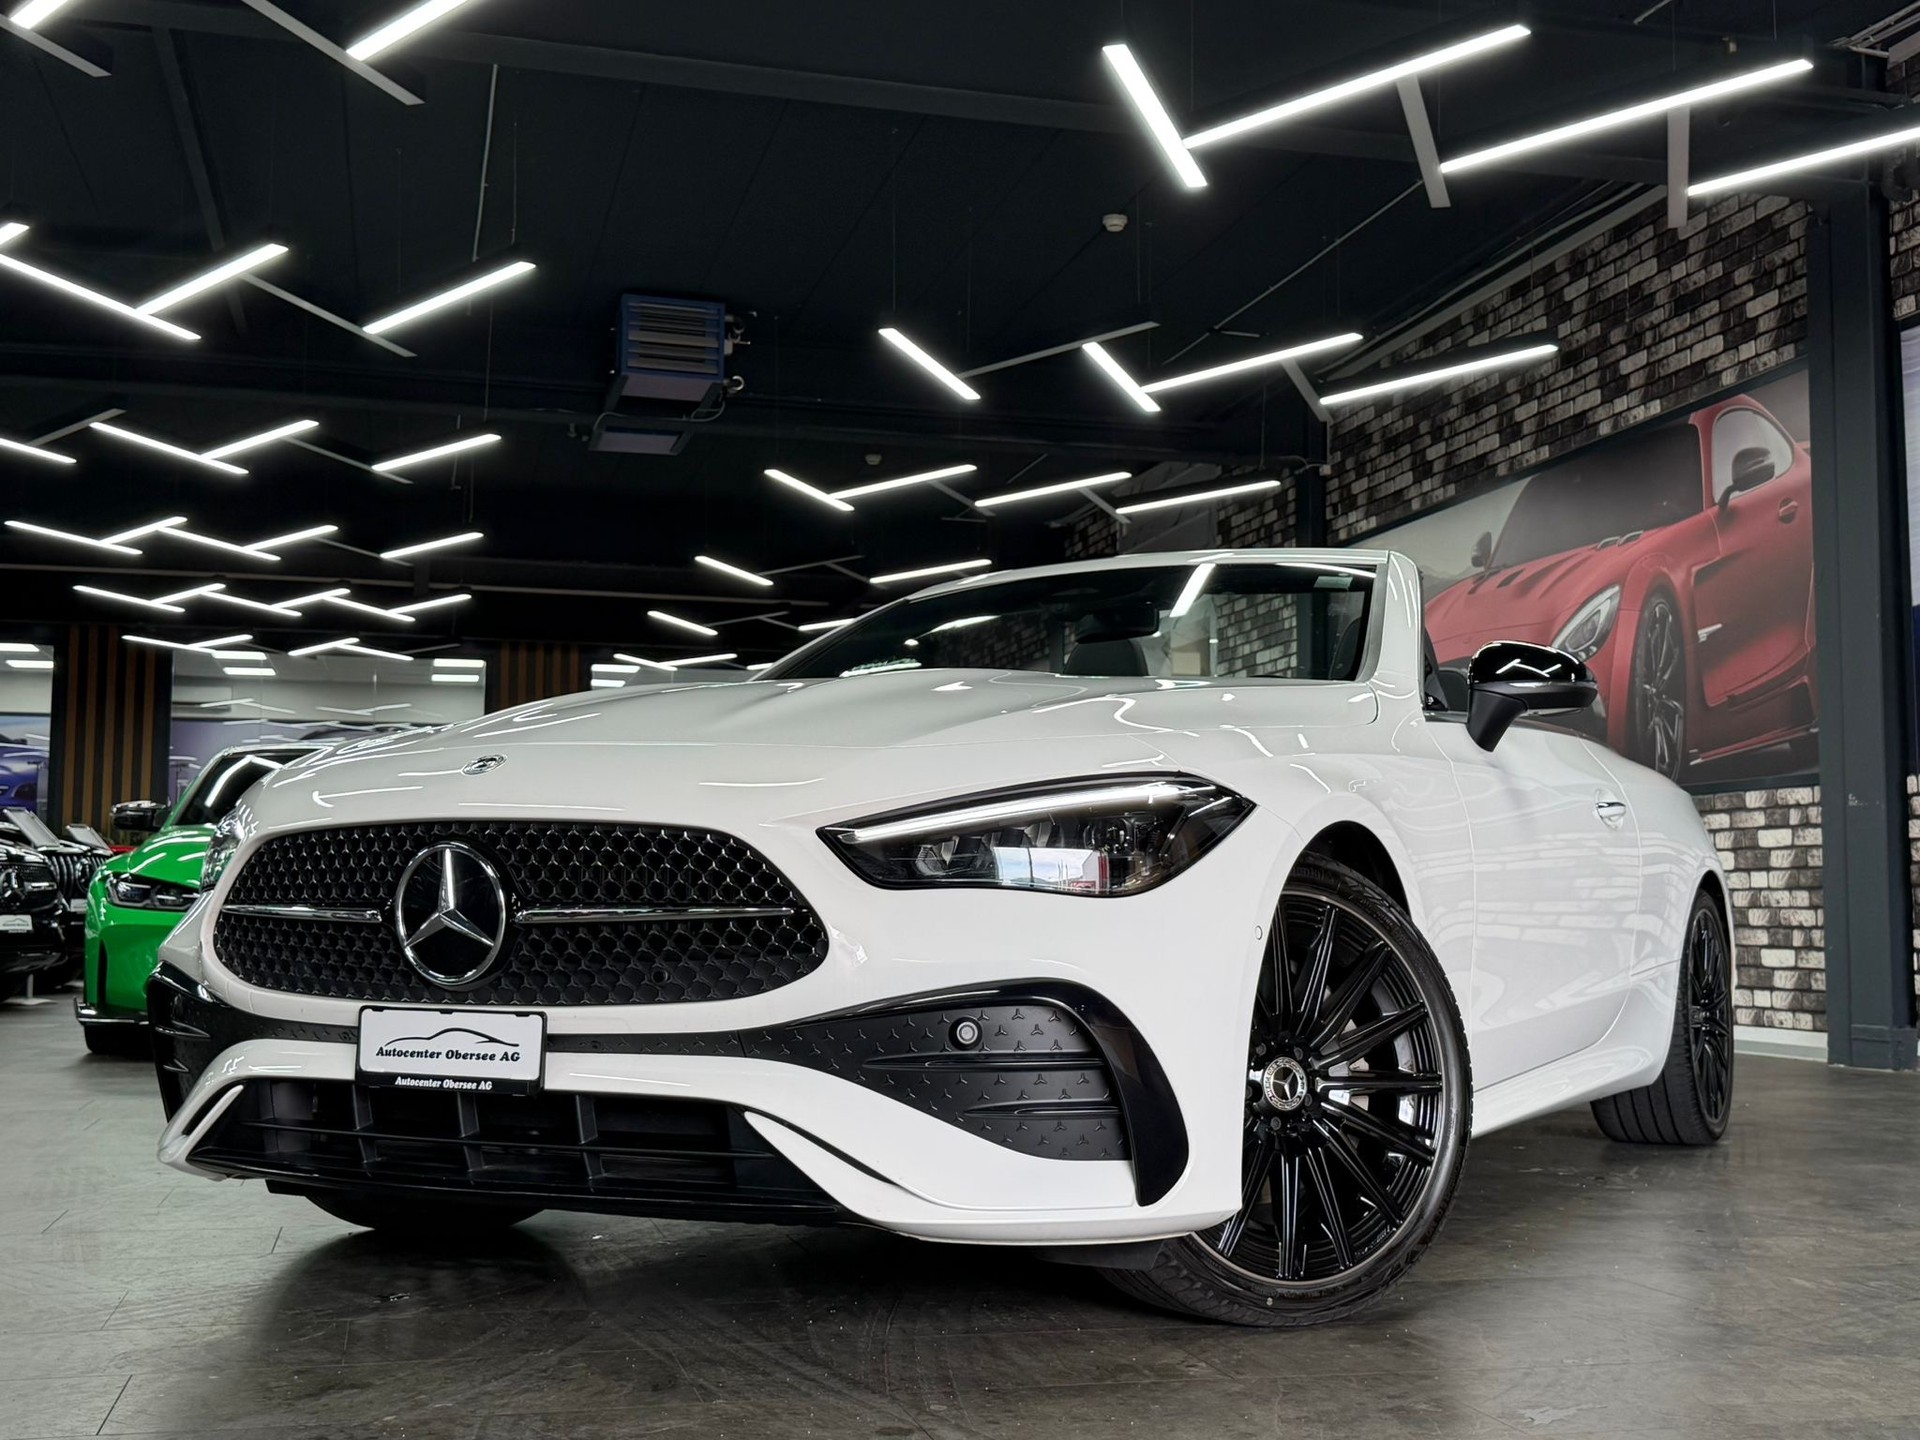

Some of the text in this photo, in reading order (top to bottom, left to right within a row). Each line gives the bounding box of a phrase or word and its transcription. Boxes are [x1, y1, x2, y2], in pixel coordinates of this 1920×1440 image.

[376, 1046, 521, 1062] Autocenter Obersee AG
[394, 1076, 493, 1091] Autocenter Obersee AG
